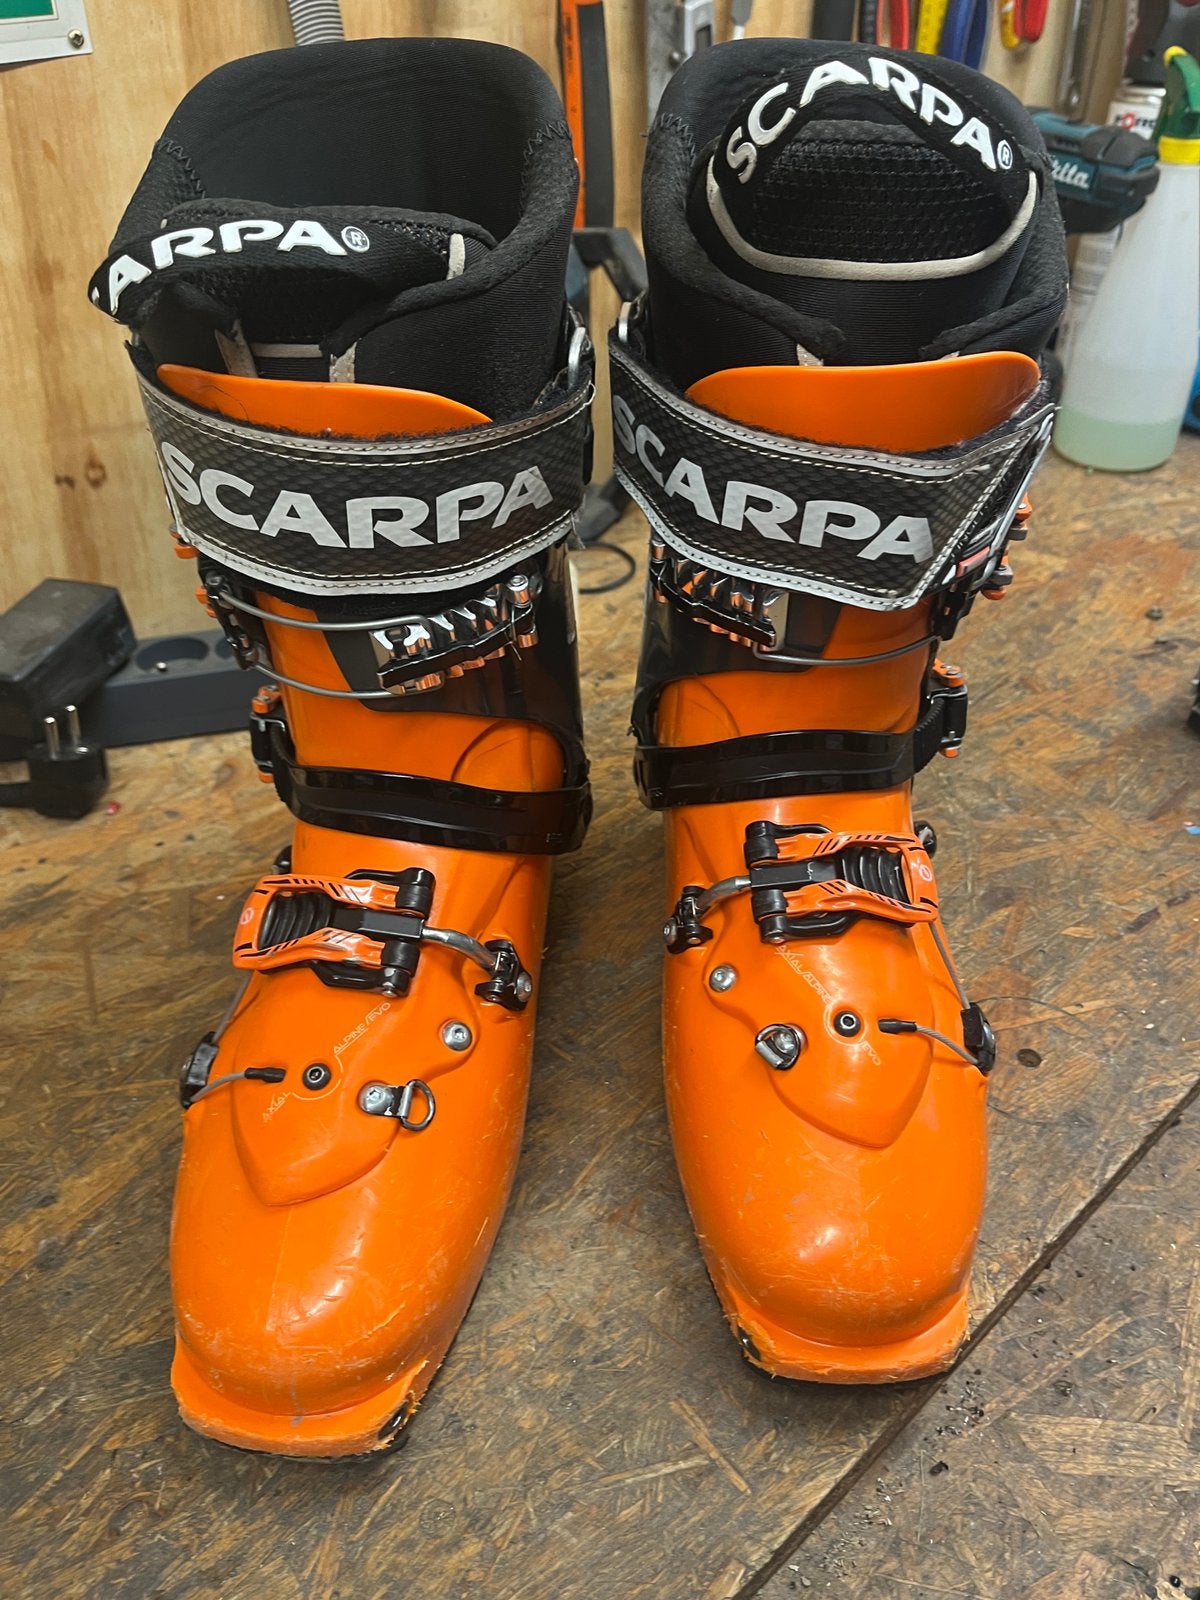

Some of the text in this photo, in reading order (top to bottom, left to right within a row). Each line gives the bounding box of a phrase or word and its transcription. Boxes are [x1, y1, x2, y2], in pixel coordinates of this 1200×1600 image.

[91, 219, 370, 316] ARPA®
[161, 441, 554, 549] SCARPA
[612, 395, 934, 563] SCARPA
